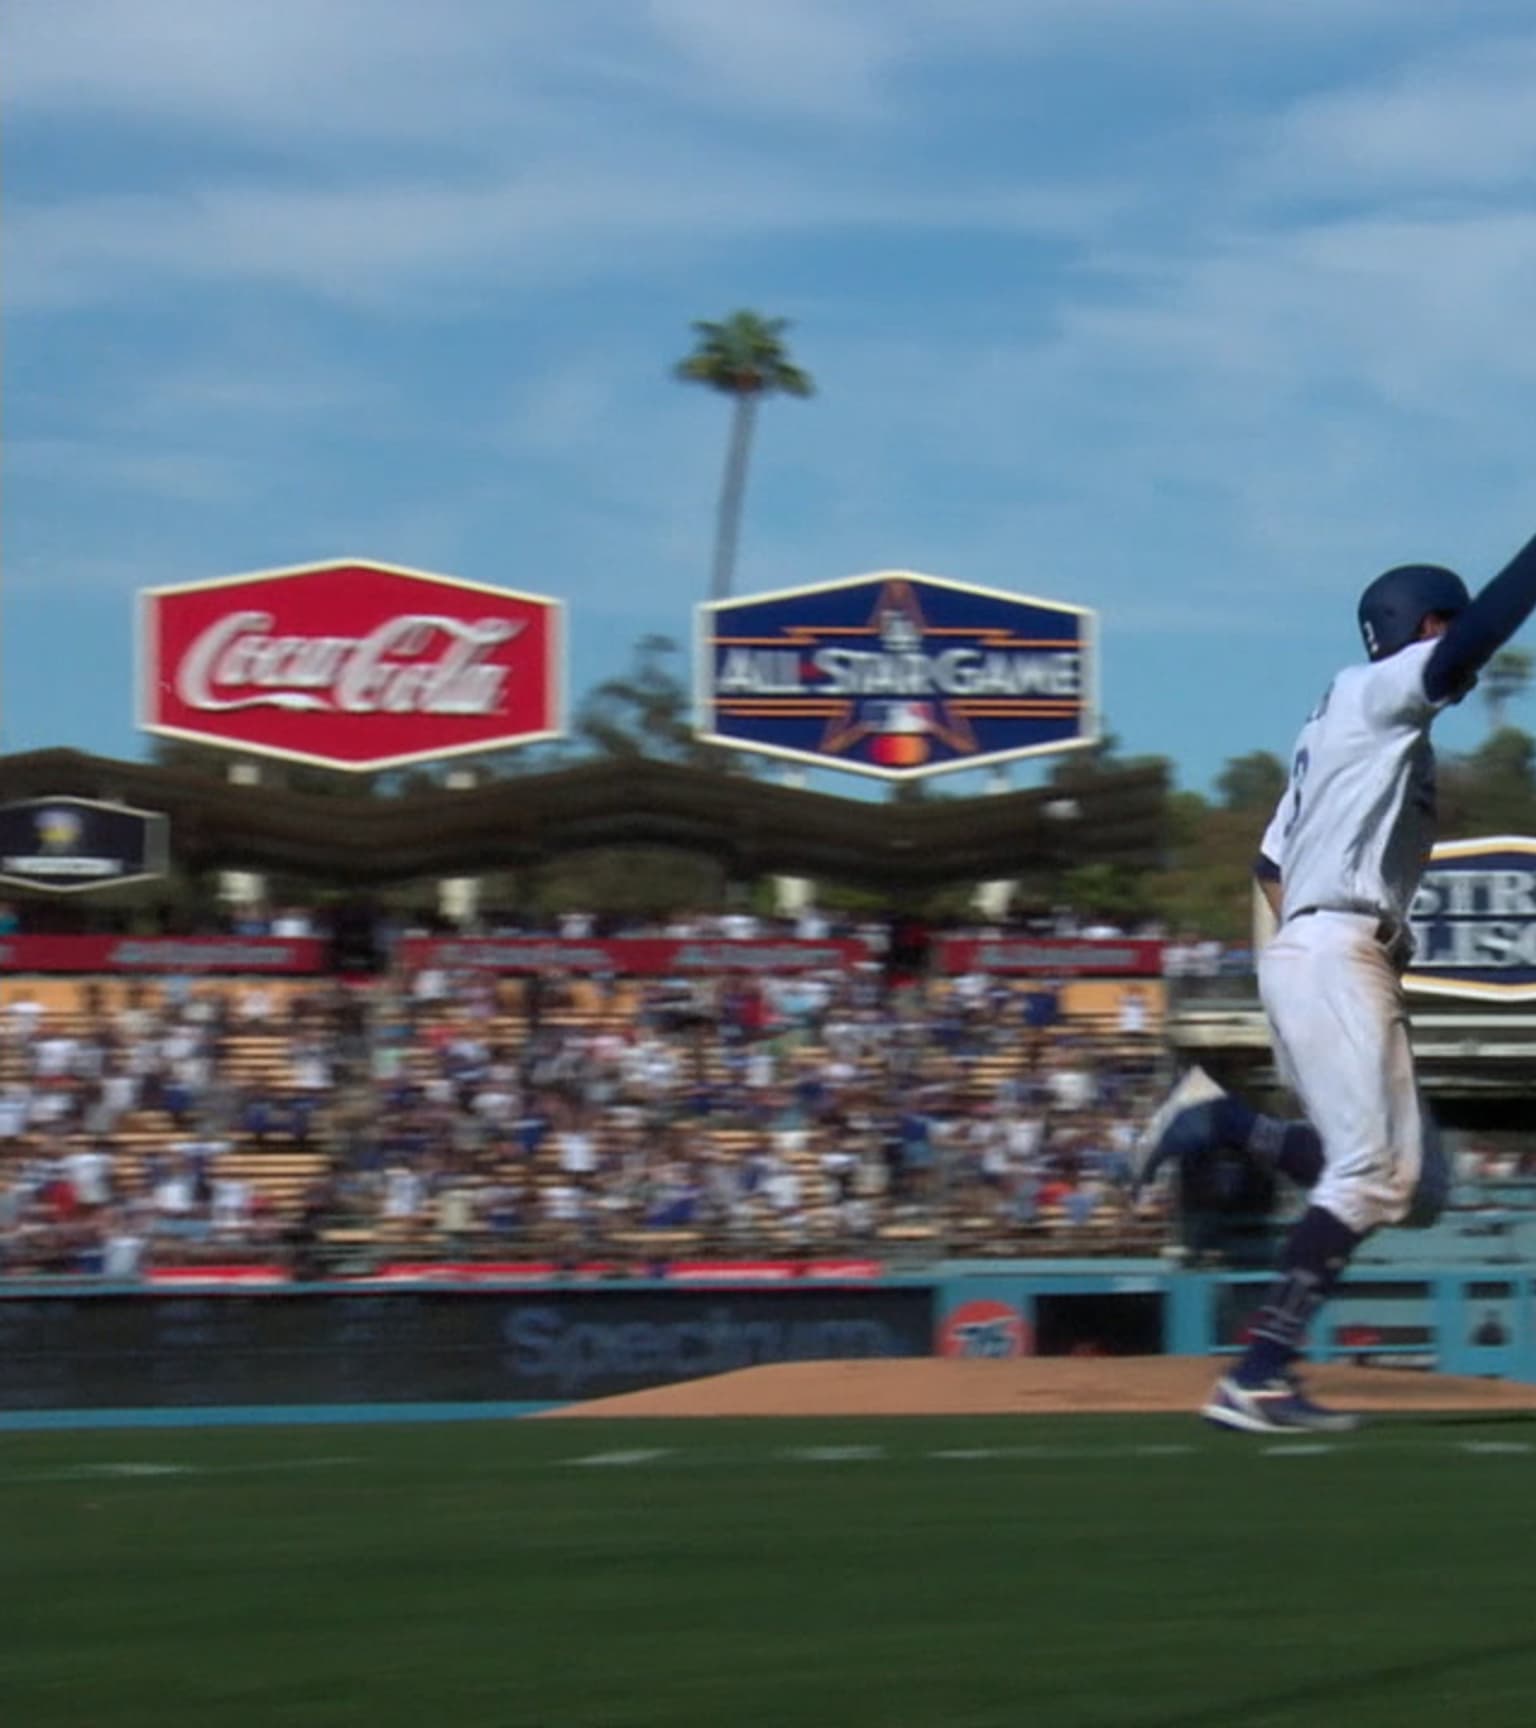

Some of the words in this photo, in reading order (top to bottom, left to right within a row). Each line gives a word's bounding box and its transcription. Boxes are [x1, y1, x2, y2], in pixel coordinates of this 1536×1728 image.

[718, 647, 806, 694] ALL
[810, 646, 938, 695] STAR
[938, 646, 1080, 696] GAME
